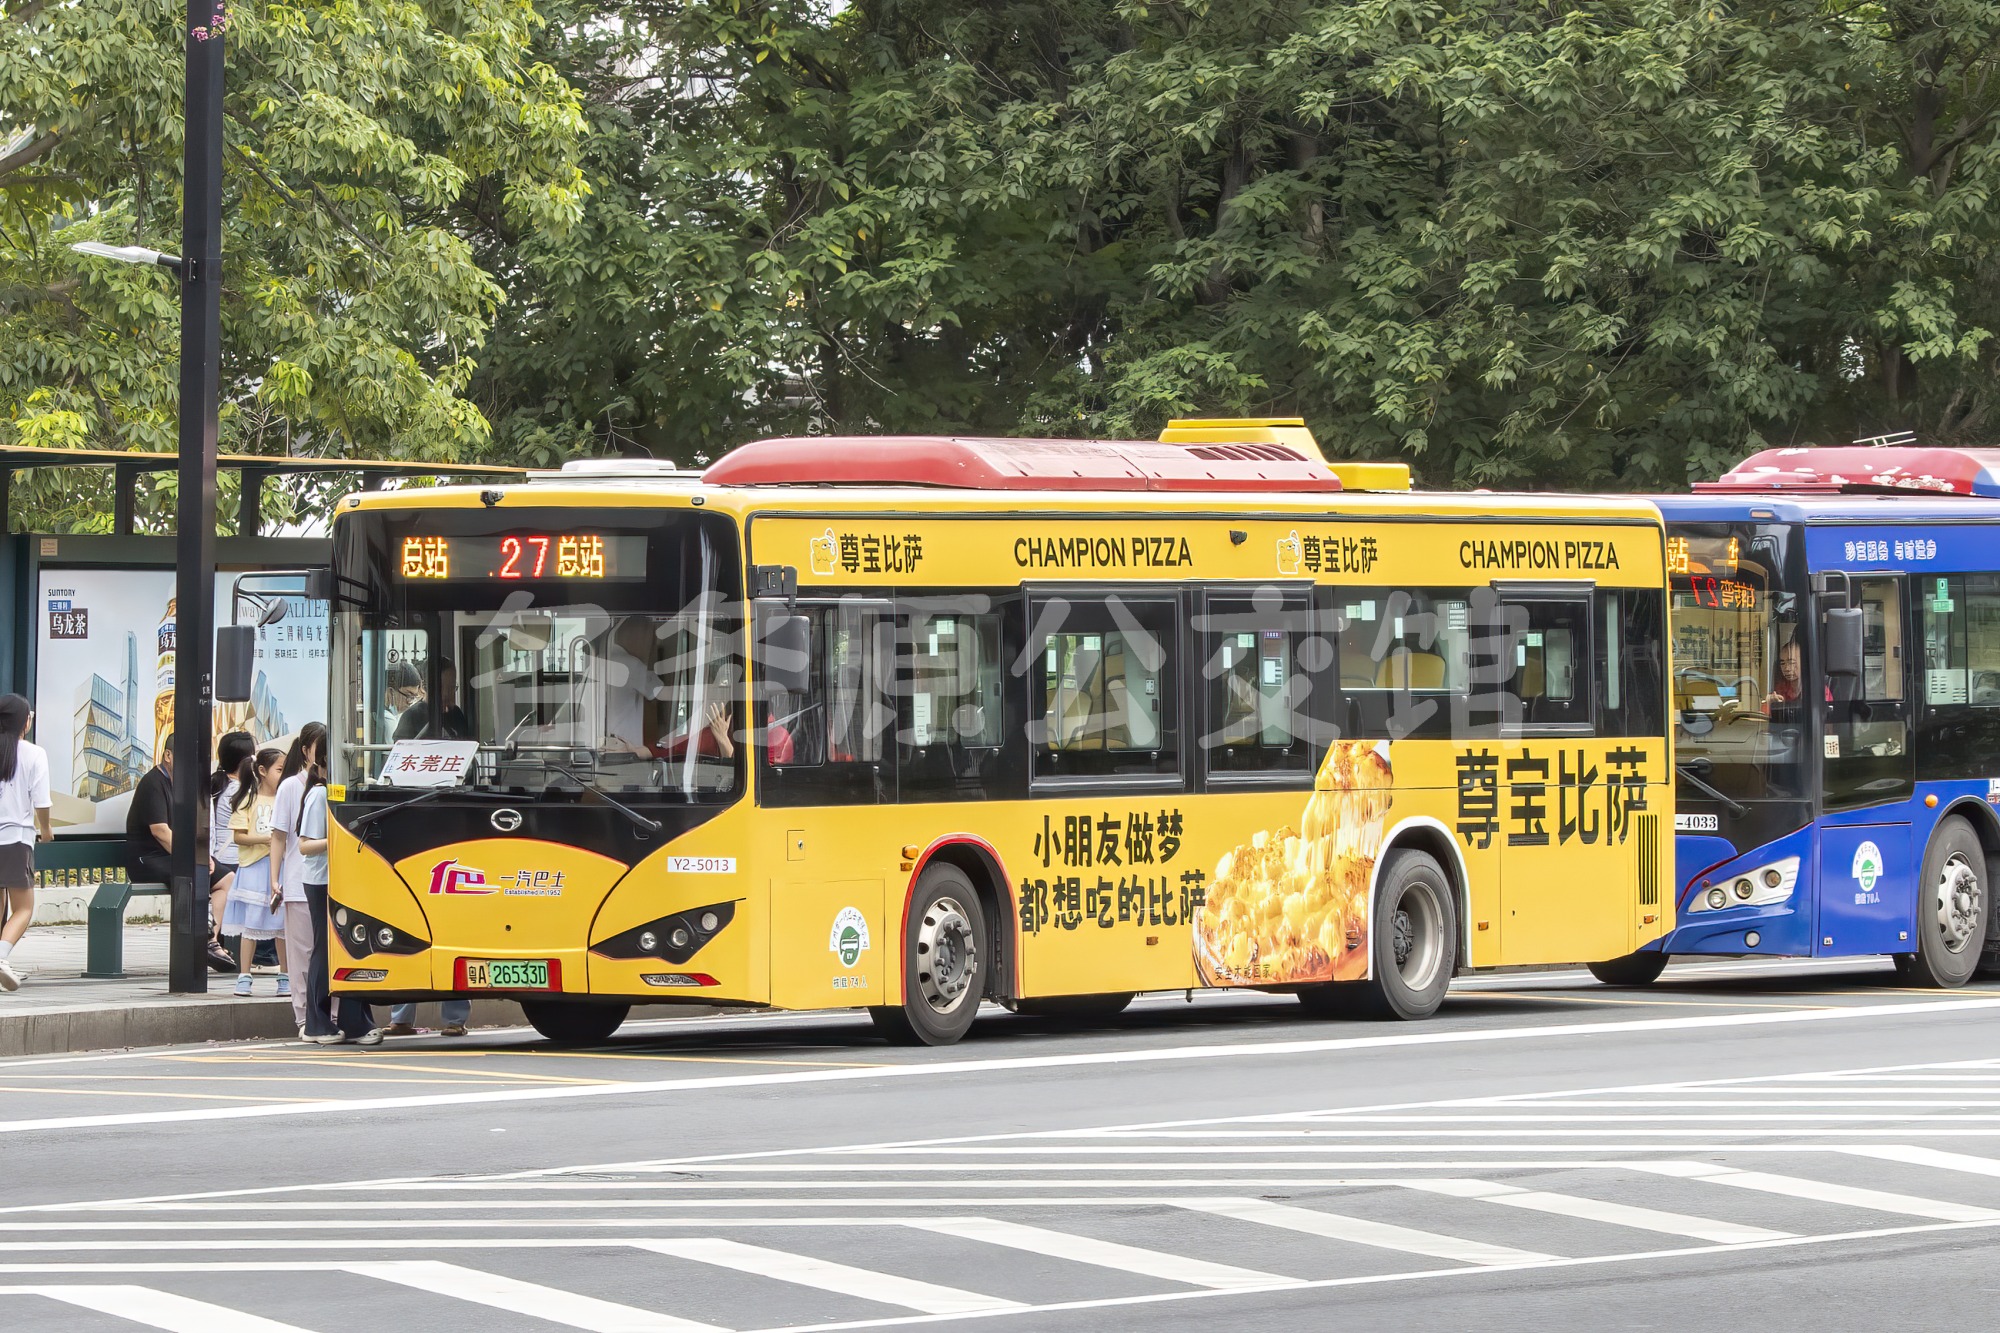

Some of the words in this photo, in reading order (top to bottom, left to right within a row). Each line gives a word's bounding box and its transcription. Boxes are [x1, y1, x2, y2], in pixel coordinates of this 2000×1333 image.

[402, 536, 449, 578] 总站
[501, 536, 549, 578] 27
[557, 535, 603, 578] 总站
[839, 533, 923, 574] 尊宝比萨
[1014, 537, 1127, 567] CHAMPION
[1132, 537, 1193, 568] PIZZA
[1302, 535, 1378, 574] 尊宝比萨
[1459, 540, 1559, 569] CHAMPION
[1565, 541, 1619, 570] PIZZA
[51, 613, 86, 635] 乌龙茶
[396, 754, 464, 772] 东莞庄
[1456, 746, 1648, 848] 尊宝比萨
[1676, 816, 1716, 828] -4033
[1033, 810, 1184, 869] 小朋友做梦
[500, 870, 565, 887] 一汽巴士
[674, 858, 729, 871] Y2-5013
[1019, 868, 1206, 937] 都想吃的比萨
[493, 965, 547, 984] 26533D
[1214, 964, 1271, 980] 安全才能回家
